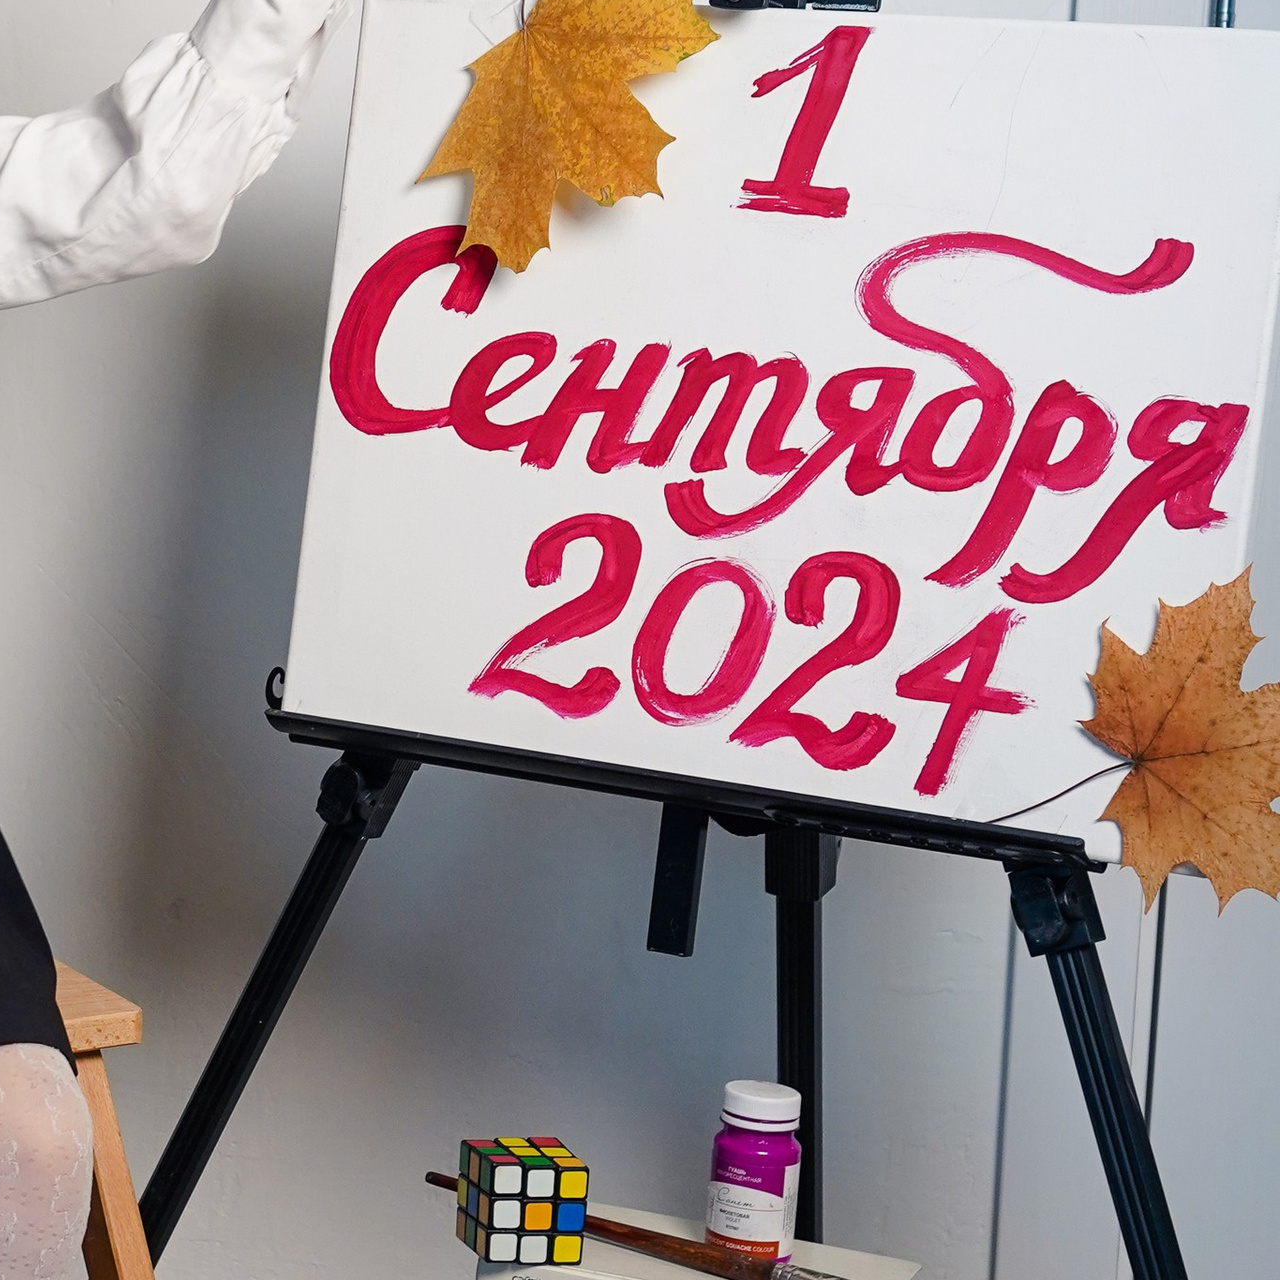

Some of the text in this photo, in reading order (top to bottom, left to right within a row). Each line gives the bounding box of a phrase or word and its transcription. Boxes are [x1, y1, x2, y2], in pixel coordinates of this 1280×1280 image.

[730, 25, 876, 218] 1
[330, 225, 1250, 604] Сентября
[466, 513, 1037, 798] 2024
